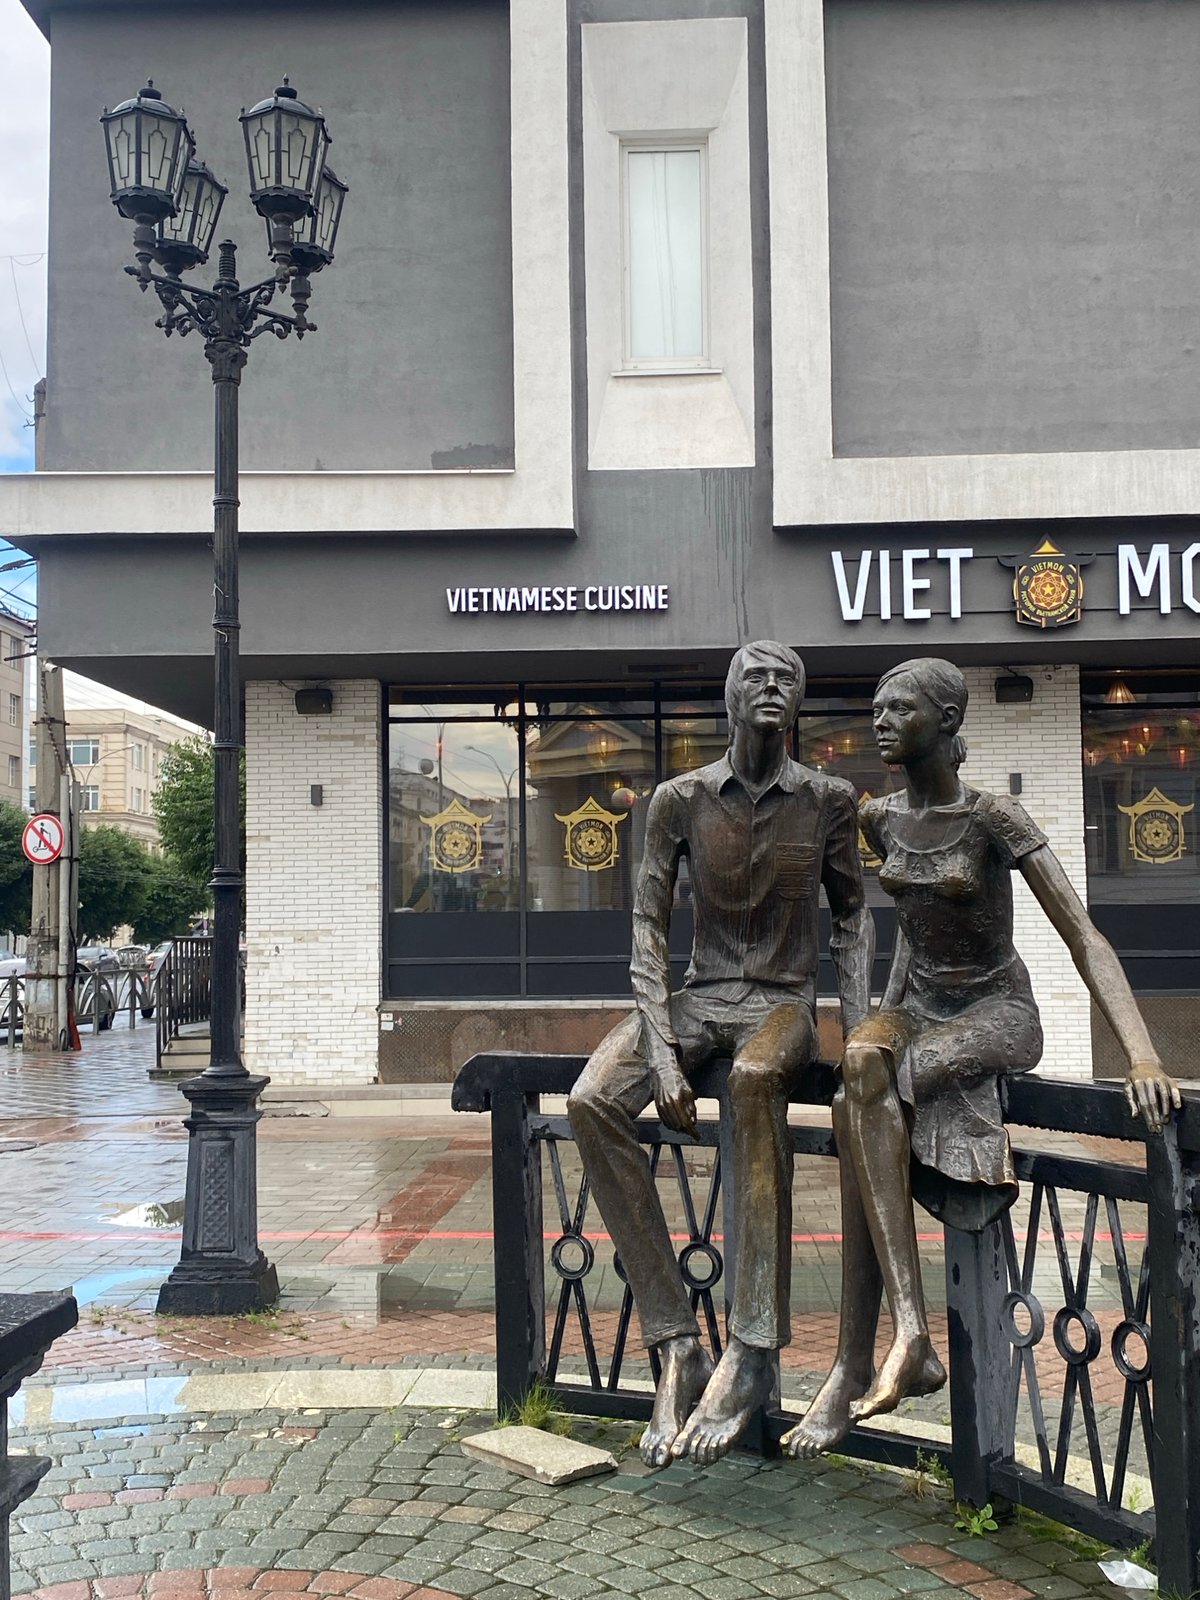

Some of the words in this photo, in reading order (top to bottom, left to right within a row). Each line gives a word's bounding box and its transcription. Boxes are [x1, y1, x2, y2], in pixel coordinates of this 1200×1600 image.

[1031, 562, 1064, 573] VIETMON
[831, 548, 973, 621] VIET
[446, 586, 577, 612] VIETNAMESE
[584, 585, 668, 610] CUISINE
